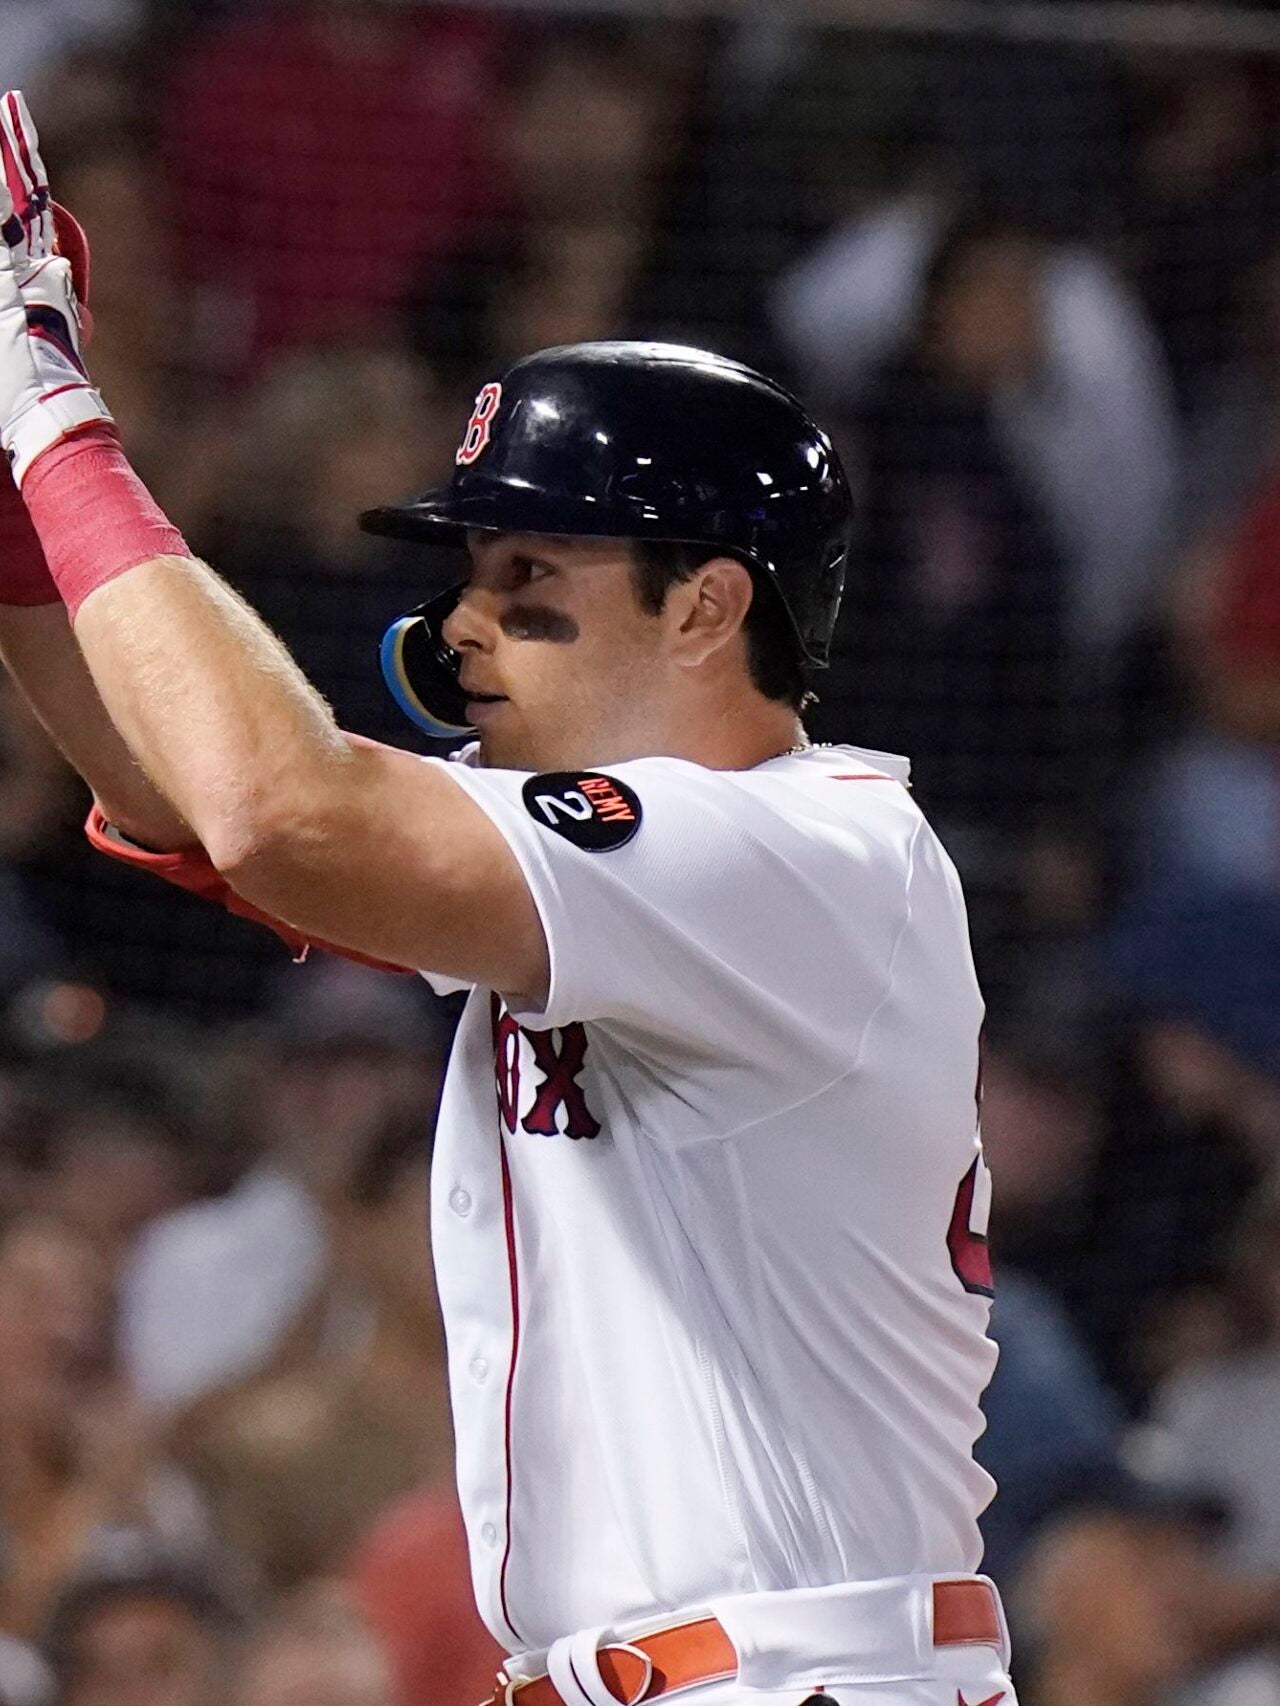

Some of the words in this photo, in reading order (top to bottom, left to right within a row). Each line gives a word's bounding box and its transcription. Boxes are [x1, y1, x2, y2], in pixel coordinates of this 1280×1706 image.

[456, 383, 502, 465] B
[534, 790, 594, 825] 2
[577, 778, 635, 822] REMY
[490, 990, 602, 1140] OX
